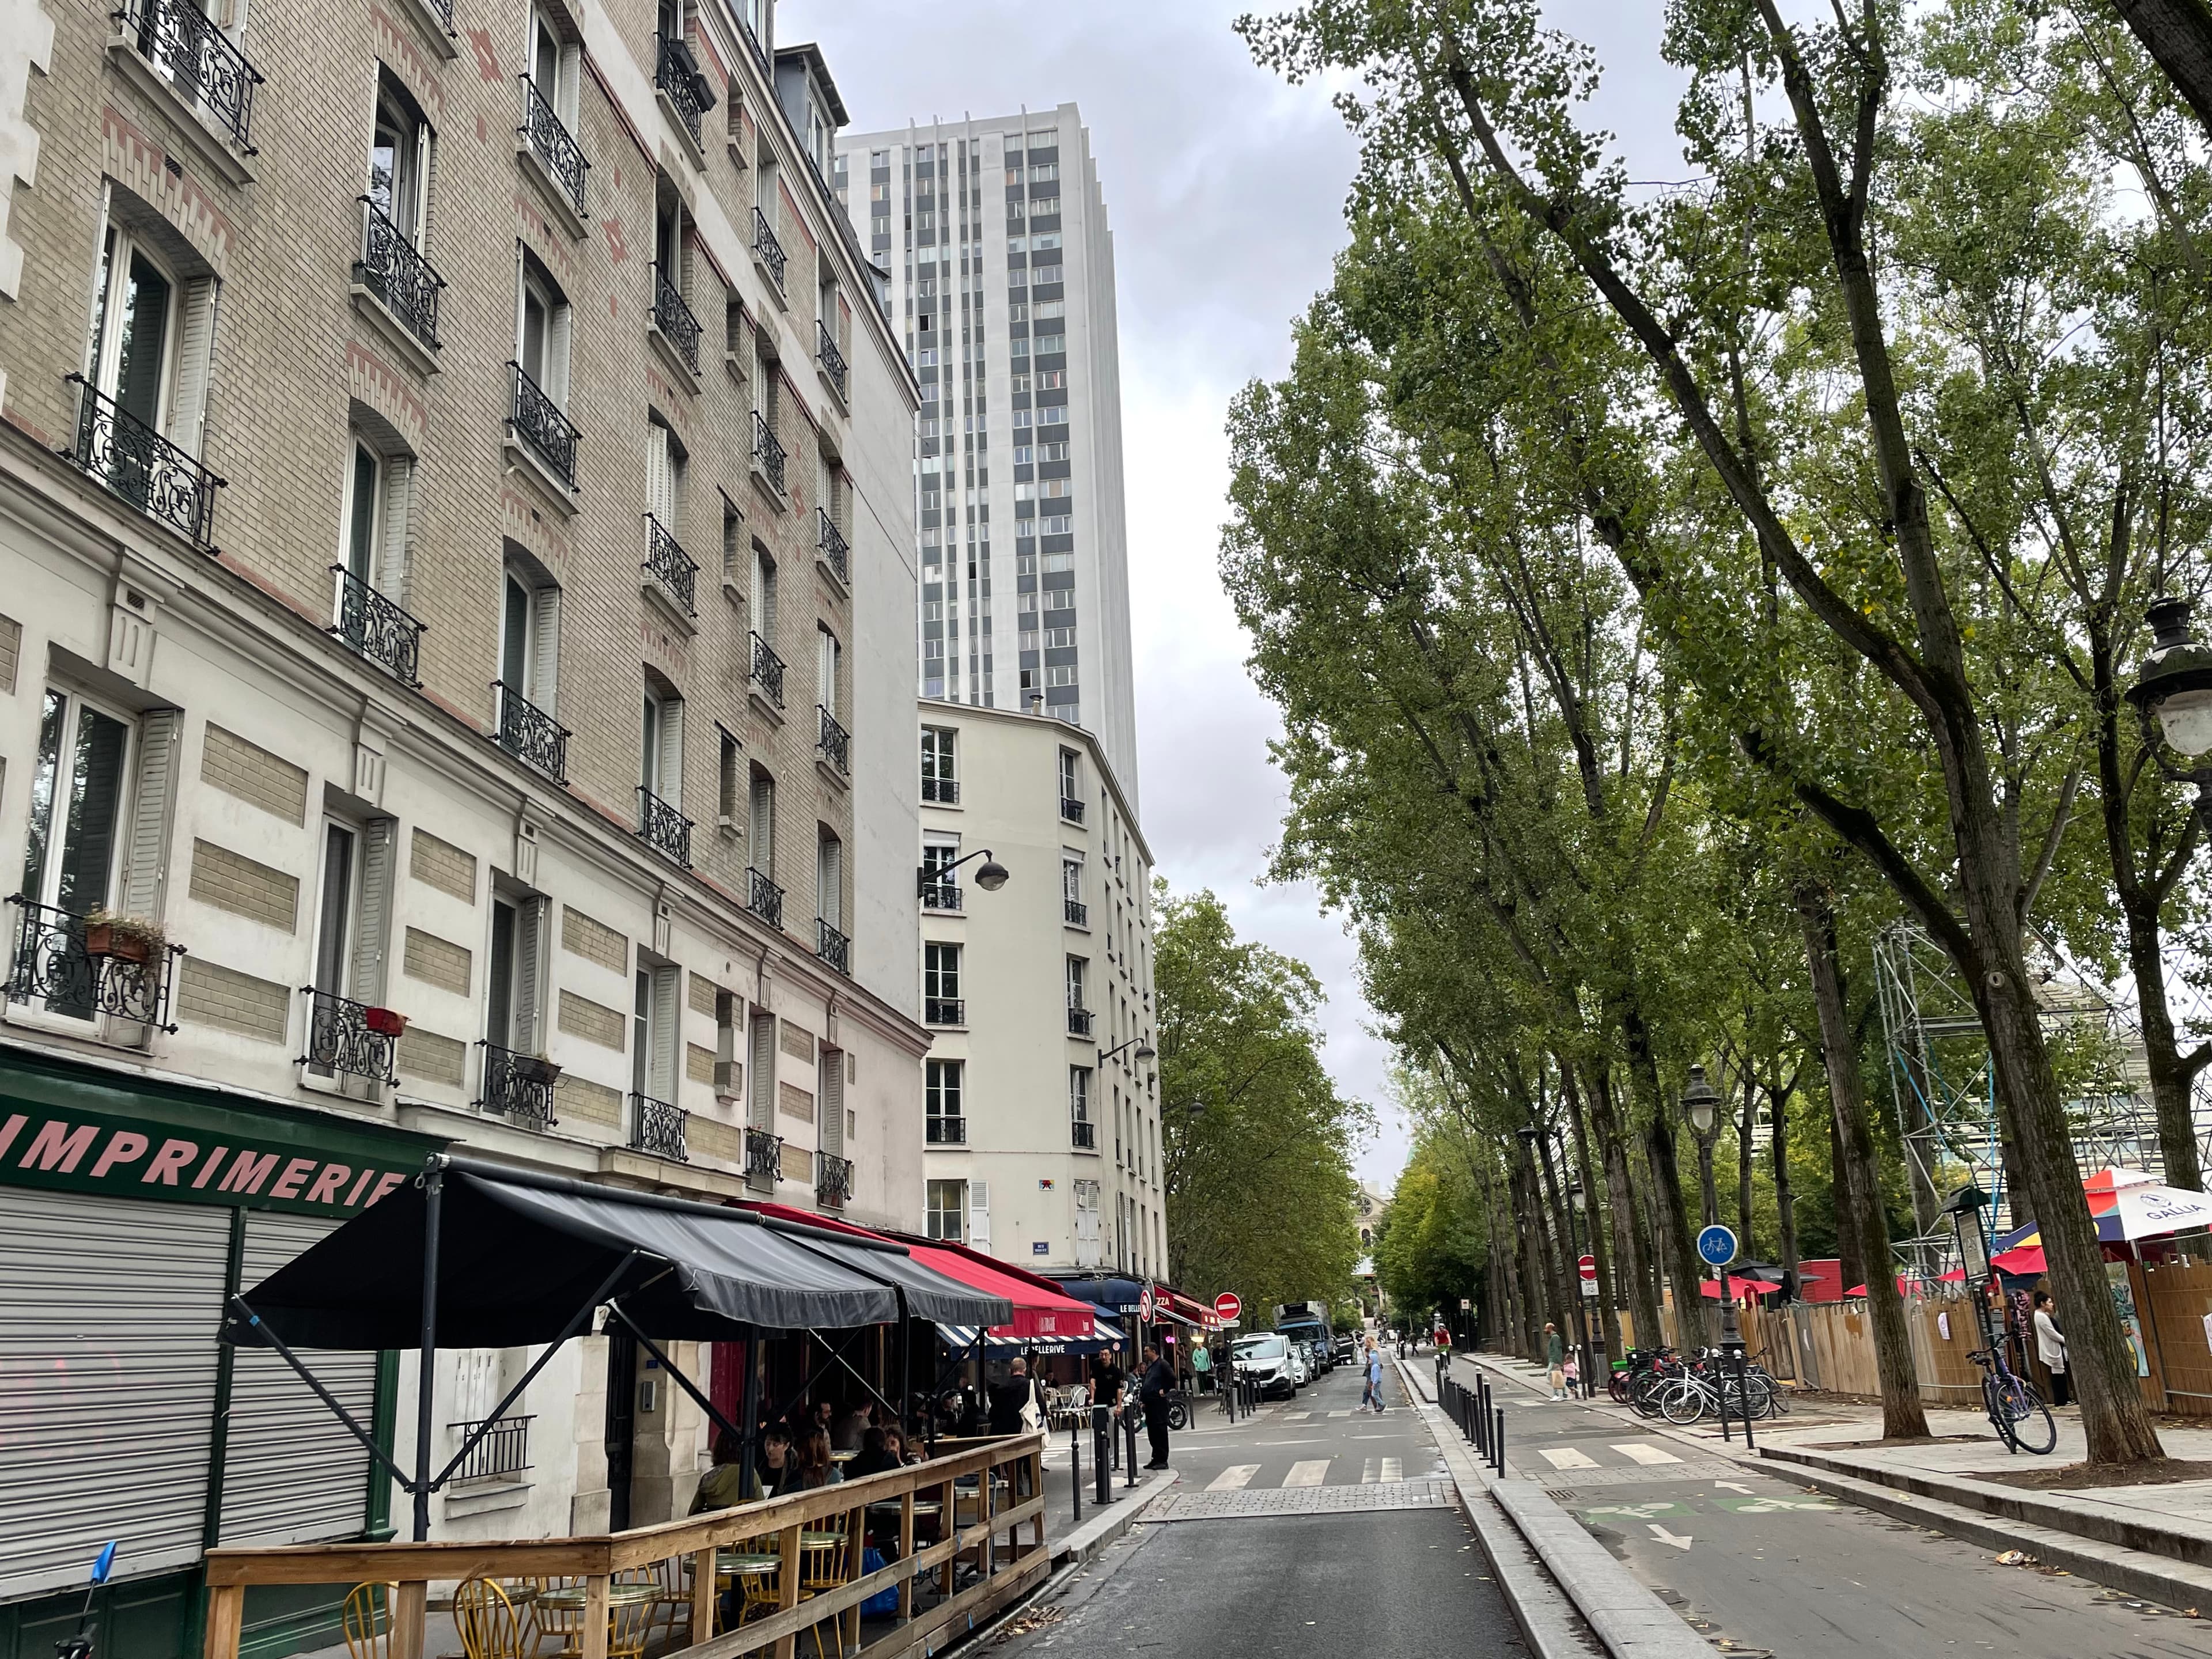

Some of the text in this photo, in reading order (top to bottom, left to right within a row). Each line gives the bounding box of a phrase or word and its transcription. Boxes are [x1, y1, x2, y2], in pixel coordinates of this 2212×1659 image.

[0, 1113, 407, 1208] IMPRIMERIE
[2146, 1204, 2207, 1220] GALLIA
[1120, 1304, 1127, 1313] LE
[1032, 1344, 1065, 1354] ELLERIVE
